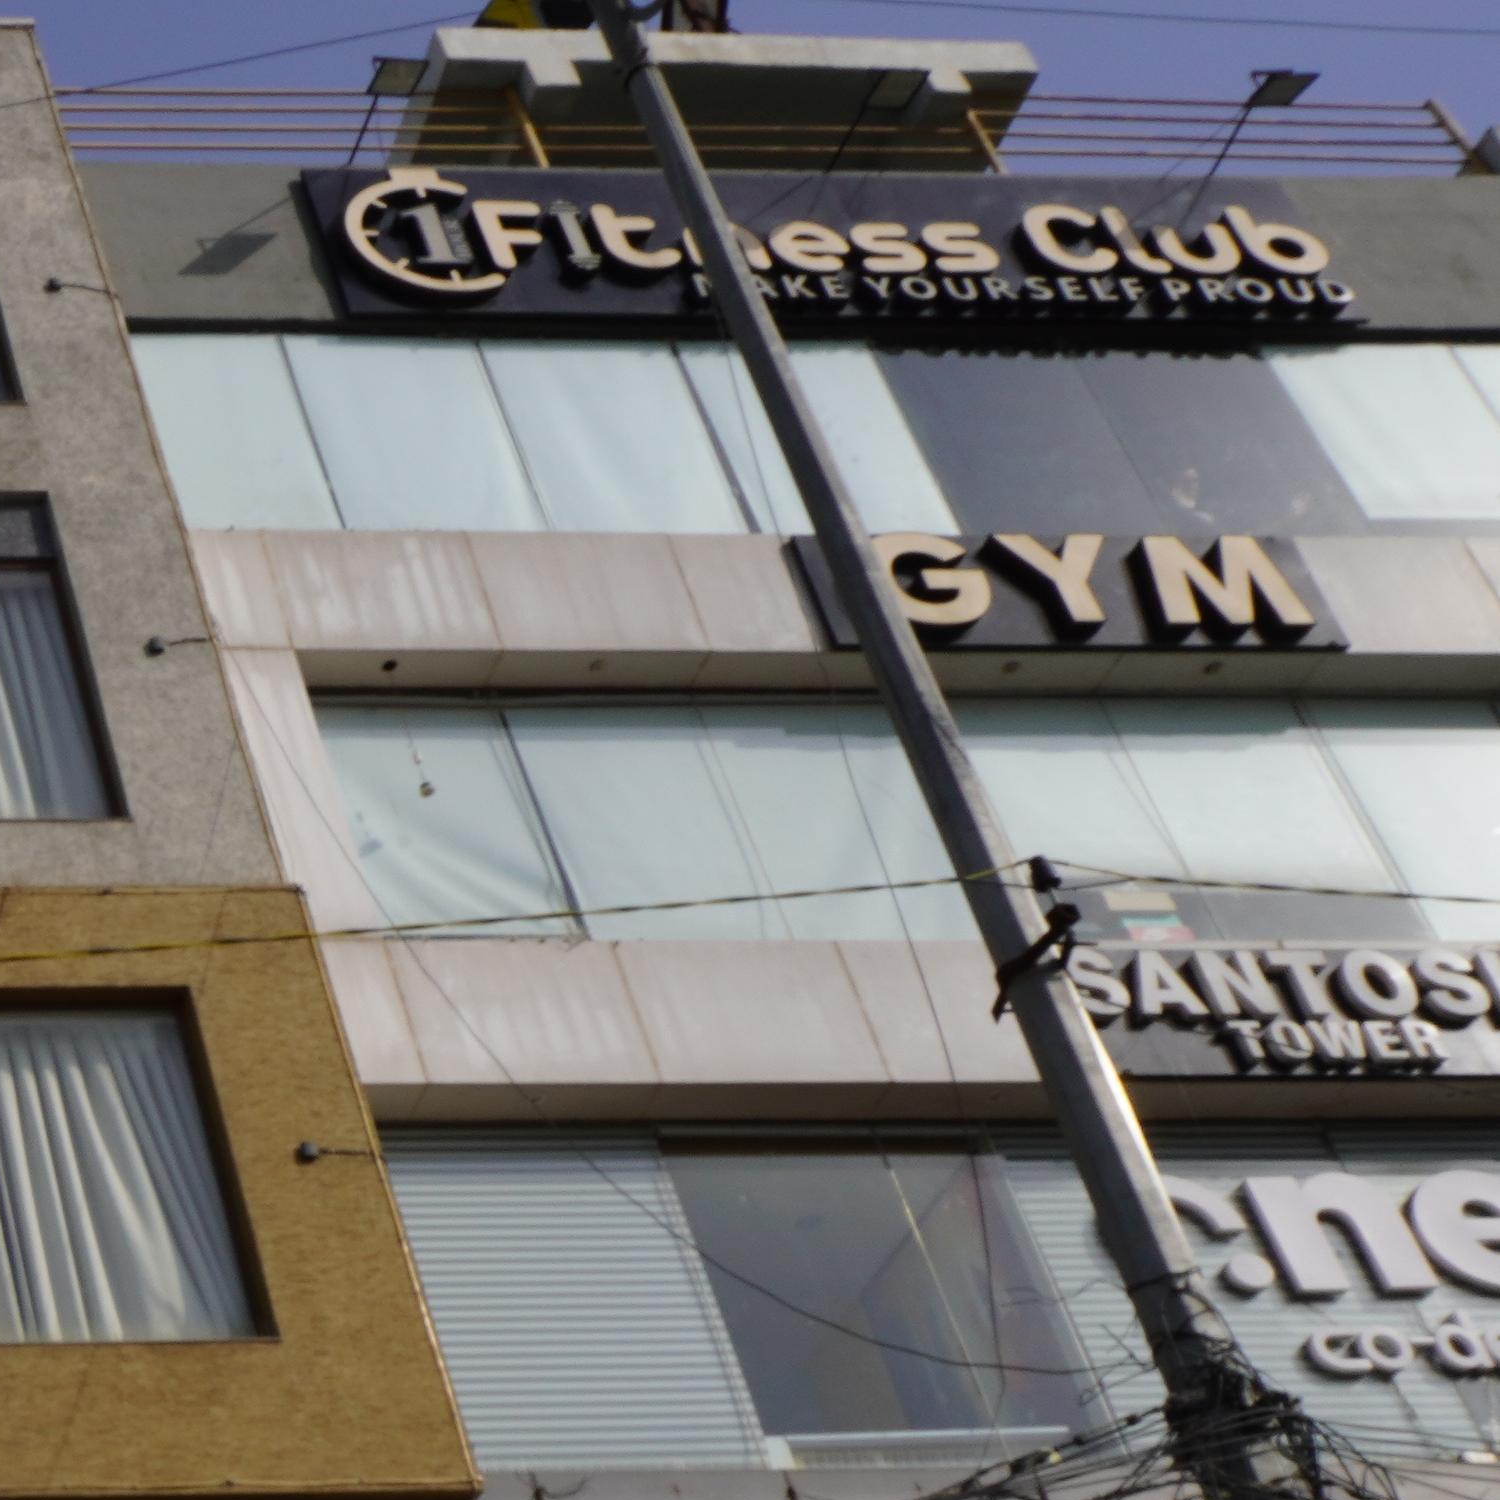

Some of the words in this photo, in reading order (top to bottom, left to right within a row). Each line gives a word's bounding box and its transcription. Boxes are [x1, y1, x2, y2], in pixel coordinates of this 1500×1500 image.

[1022, 204, 1330, 274] Club
[1161, 277, 1355, 302] PROUD
[870, 531, 1315, 626] GYM
[1226, 1019, 1448, 1061] TOWER
